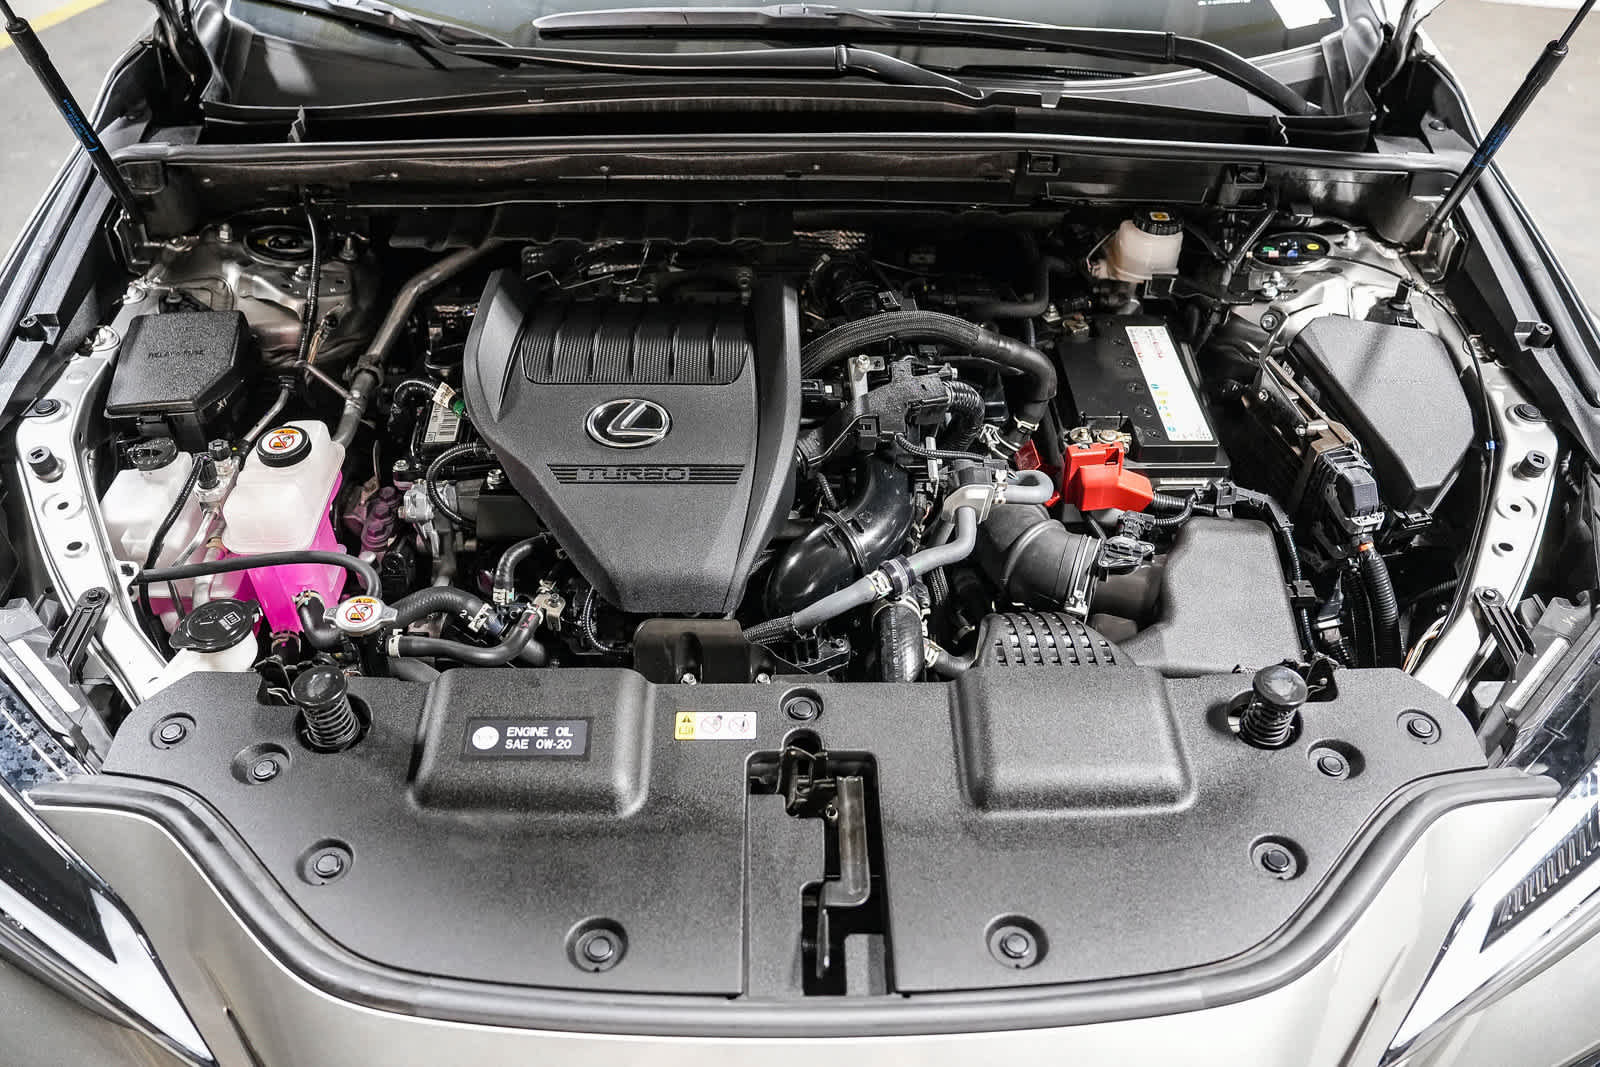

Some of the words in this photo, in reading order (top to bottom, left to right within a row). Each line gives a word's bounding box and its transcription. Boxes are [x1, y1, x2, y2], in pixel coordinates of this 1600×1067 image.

[580, 468, 688, 481] TURBO
[506, 726, 549, 737] ENGINE
[555, 726, 574, 737] OIL
[505, 739, 529, 749] SAE
[535, 739, 572, 749] 0W-20
